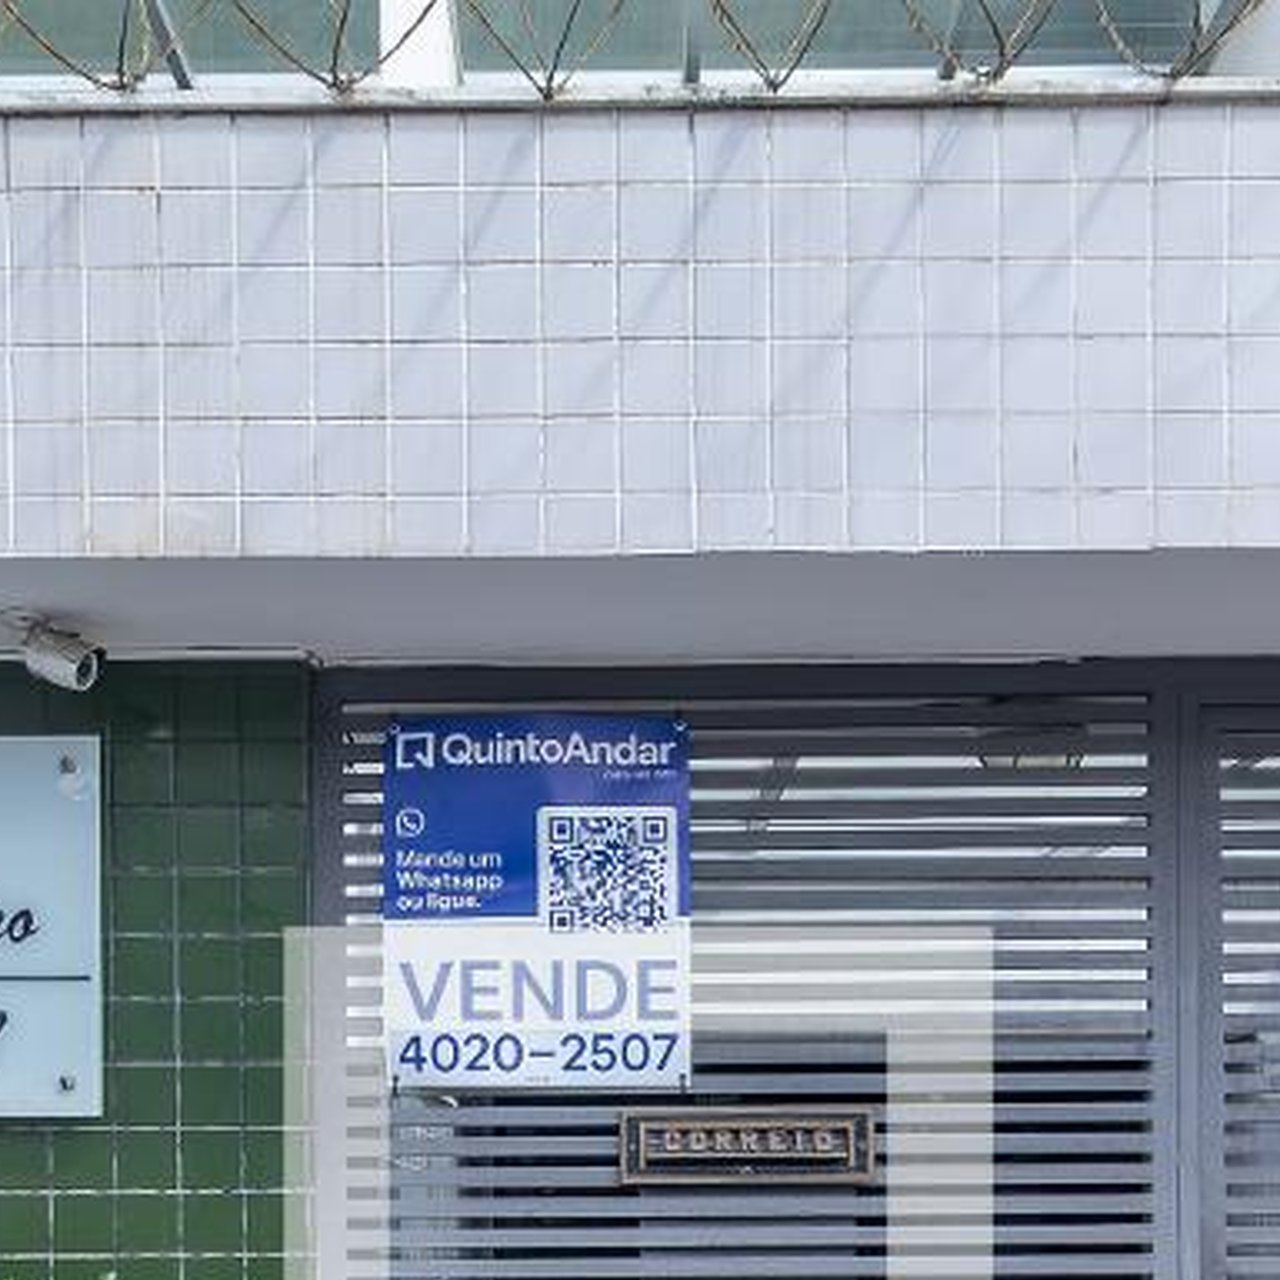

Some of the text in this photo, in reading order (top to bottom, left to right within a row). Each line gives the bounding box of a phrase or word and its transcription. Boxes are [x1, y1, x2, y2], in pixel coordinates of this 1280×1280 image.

[441, 731, 677, 767] QuintoAndar
[396, 850, 502, 869] Mande um
[396, 895, 424, 911] ou
[399, 959, 678, 1023] VENDE
[398, 1032, 678, 1074] 4020-2507
[664, 1128, 834, 1151] CORREIO
